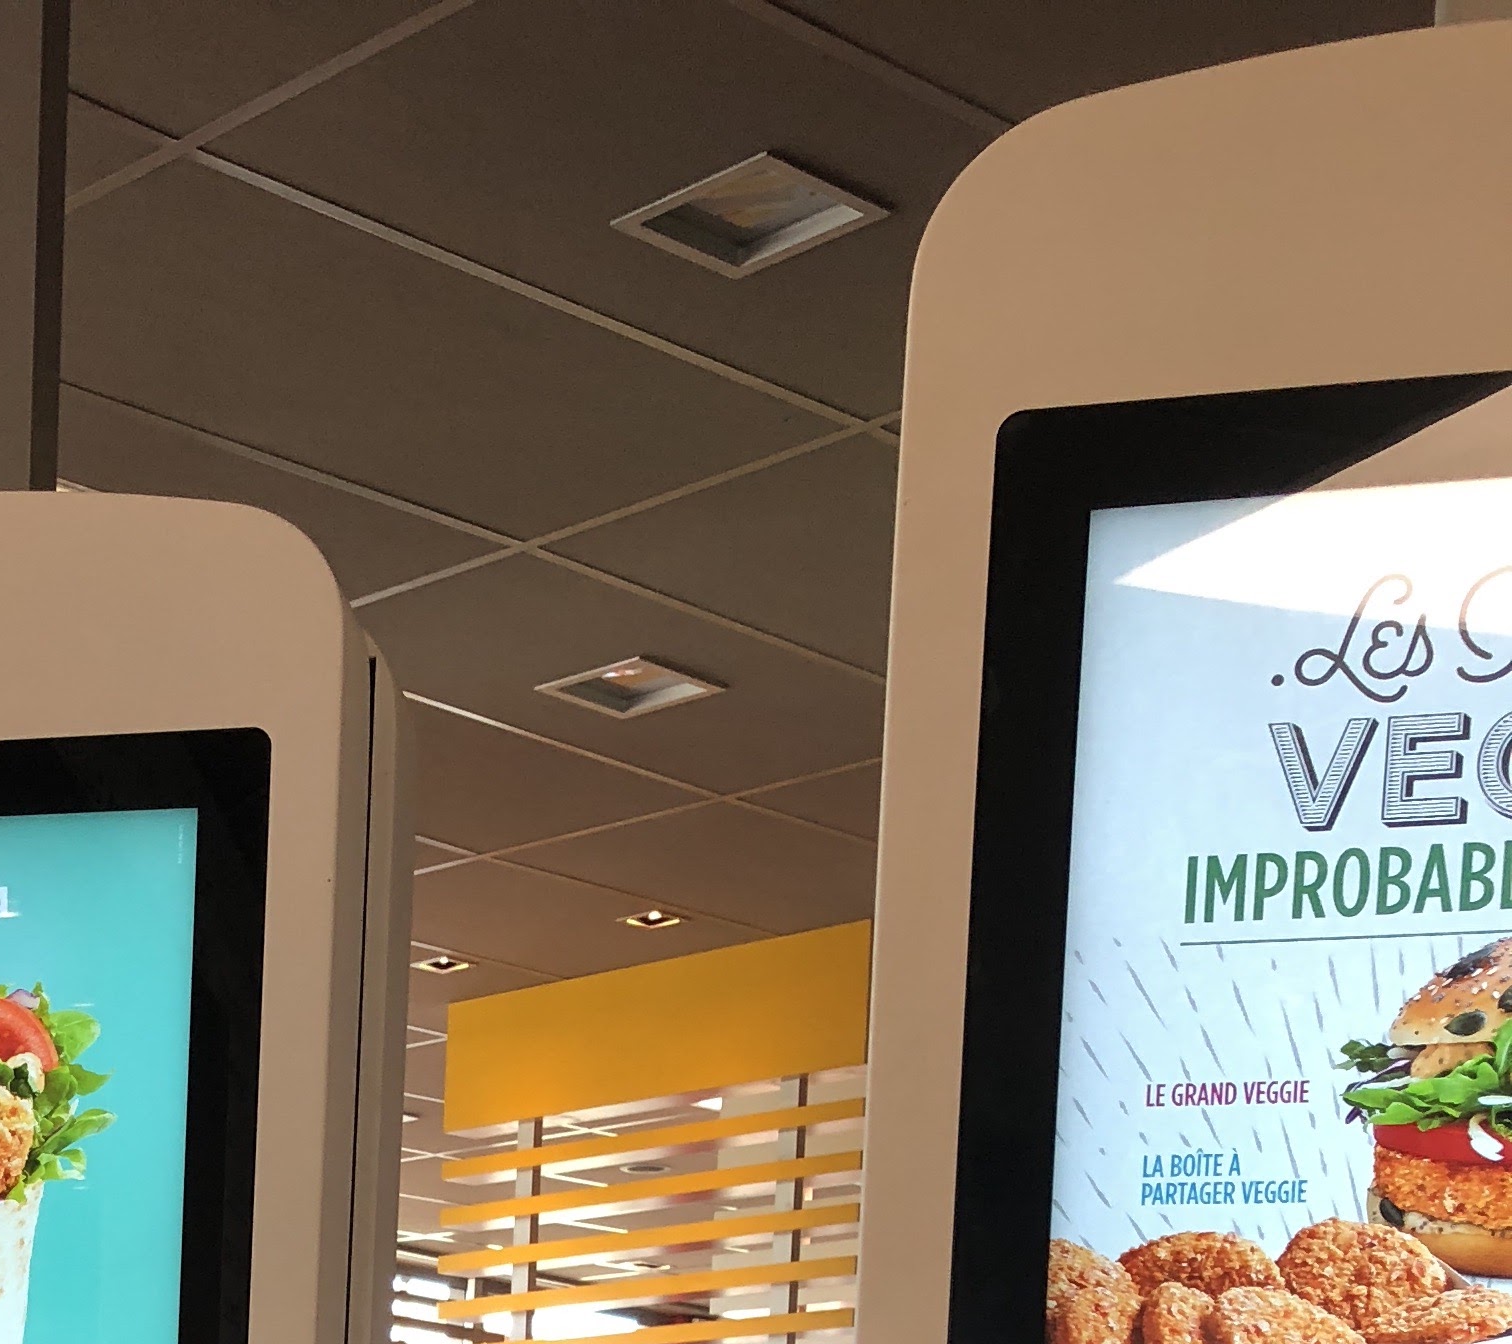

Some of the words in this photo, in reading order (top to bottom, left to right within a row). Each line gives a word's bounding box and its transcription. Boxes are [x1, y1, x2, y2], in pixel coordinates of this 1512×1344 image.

[1146, 1083, 1166, 1107] LE
[1171, 1082, 1237, 1107] GRAND
[1243, 1080, 1310, 1105] VEGGIE
[1143, 1154, 1164, 1178] LA
[1170, 1148, 1223, 1178] BOÎTE
[1228, 1147, 1241, 1177] À
[1141, 1181, 1236, 1206] PARTAGER
[1241, 1180, 1308, 1204] VEGGIE
